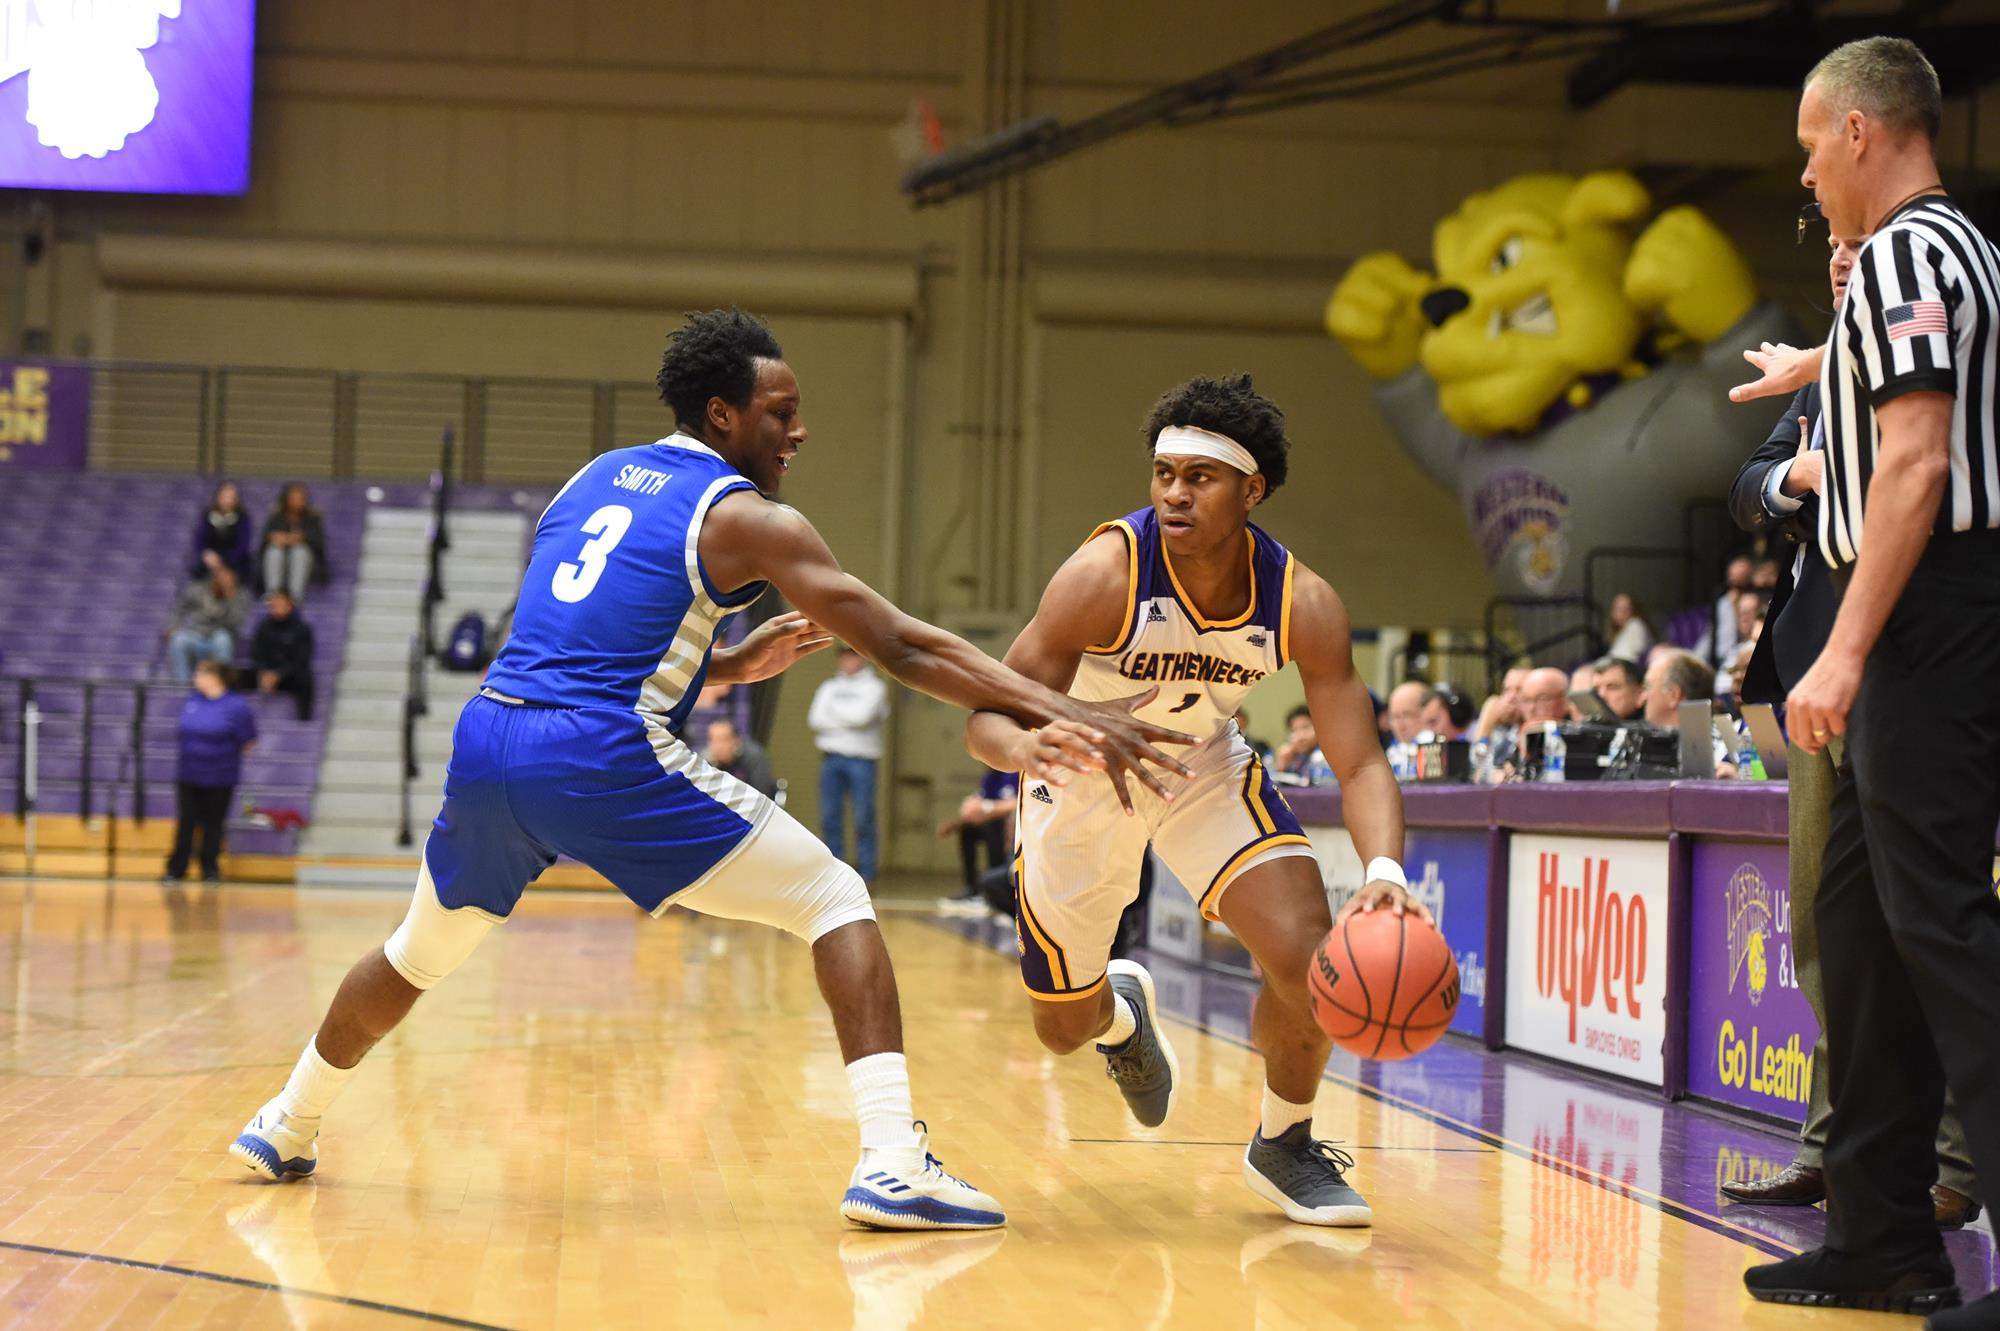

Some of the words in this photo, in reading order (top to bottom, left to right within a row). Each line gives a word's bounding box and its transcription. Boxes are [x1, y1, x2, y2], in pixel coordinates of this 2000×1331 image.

[613, 463, 673, 495] SMITH
[551, 504, 633, 604] 3
[1779, 943, 1789, 988] &
[1718, 1018, 1747, 1089] Go
